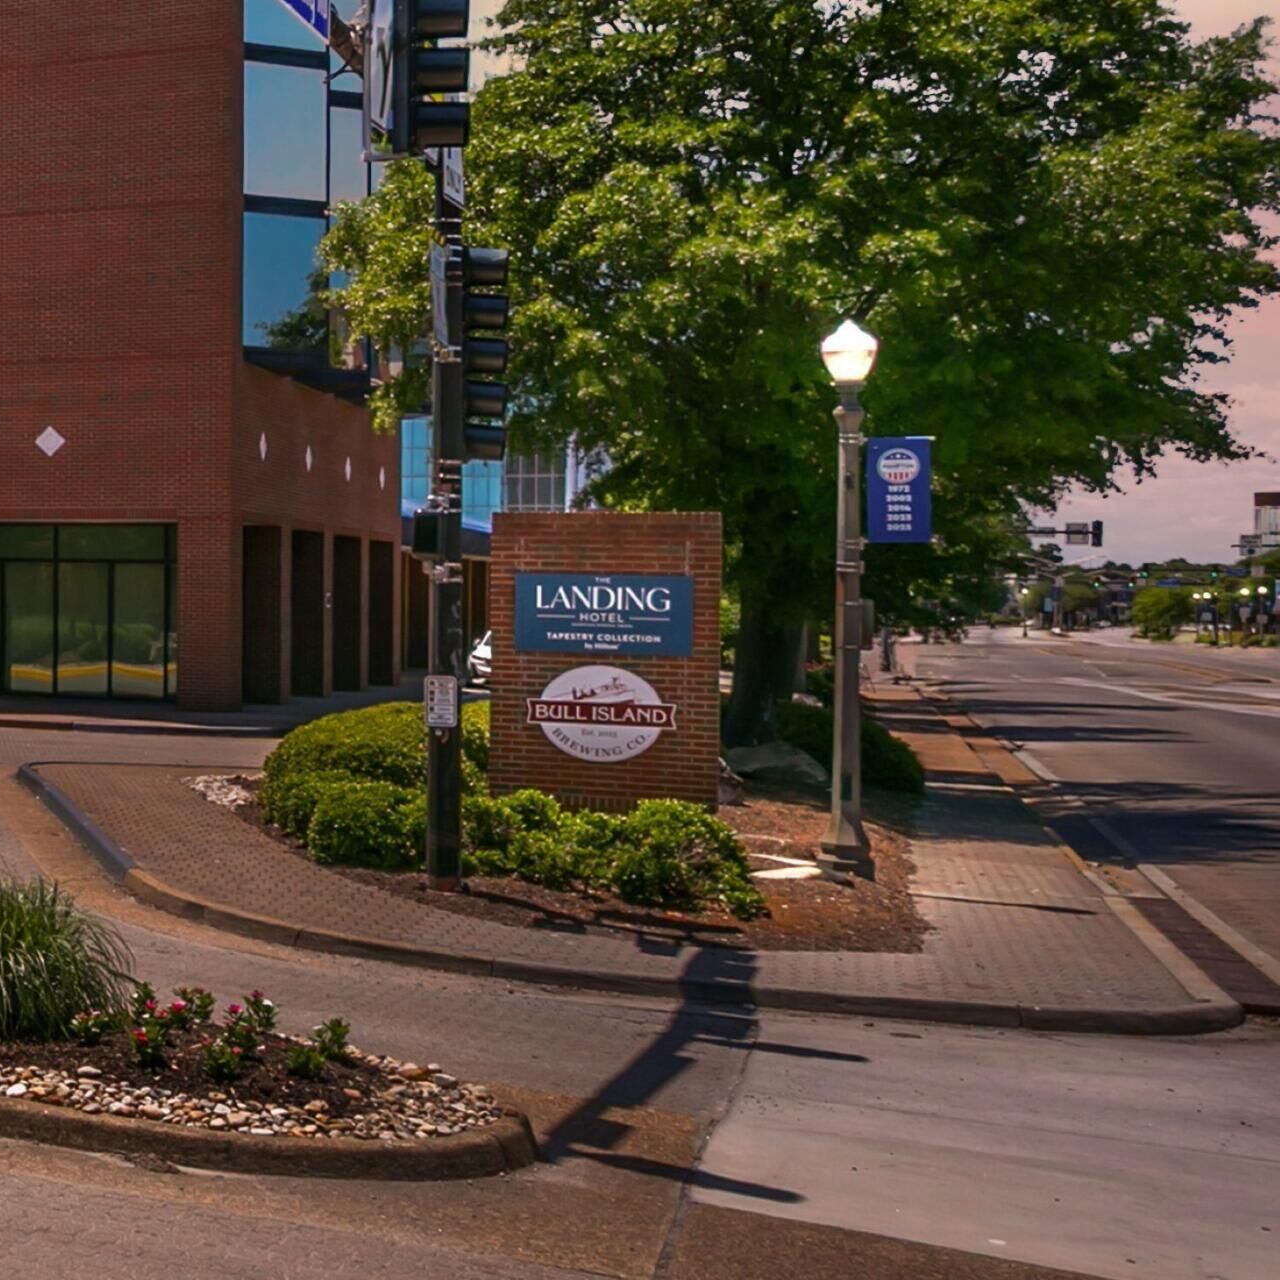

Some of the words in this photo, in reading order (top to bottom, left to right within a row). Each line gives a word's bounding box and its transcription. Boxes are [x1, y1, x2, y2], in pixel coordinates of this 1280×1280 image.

[888, 485, 910, 493] 1972
[536, 585, 671, 612] LANDING
[579, 613, 625, 623] HOTEL
[546, 632, 593, 640] TAPESTRY
[597, 633, 661, 643] COLLECTION
[535, 704, 587, 720] BULL
[591, 706, 667, 724] ISLAND
[552, 727, 623, 757] BREWING
[626, 733, 650, 751] CO.
